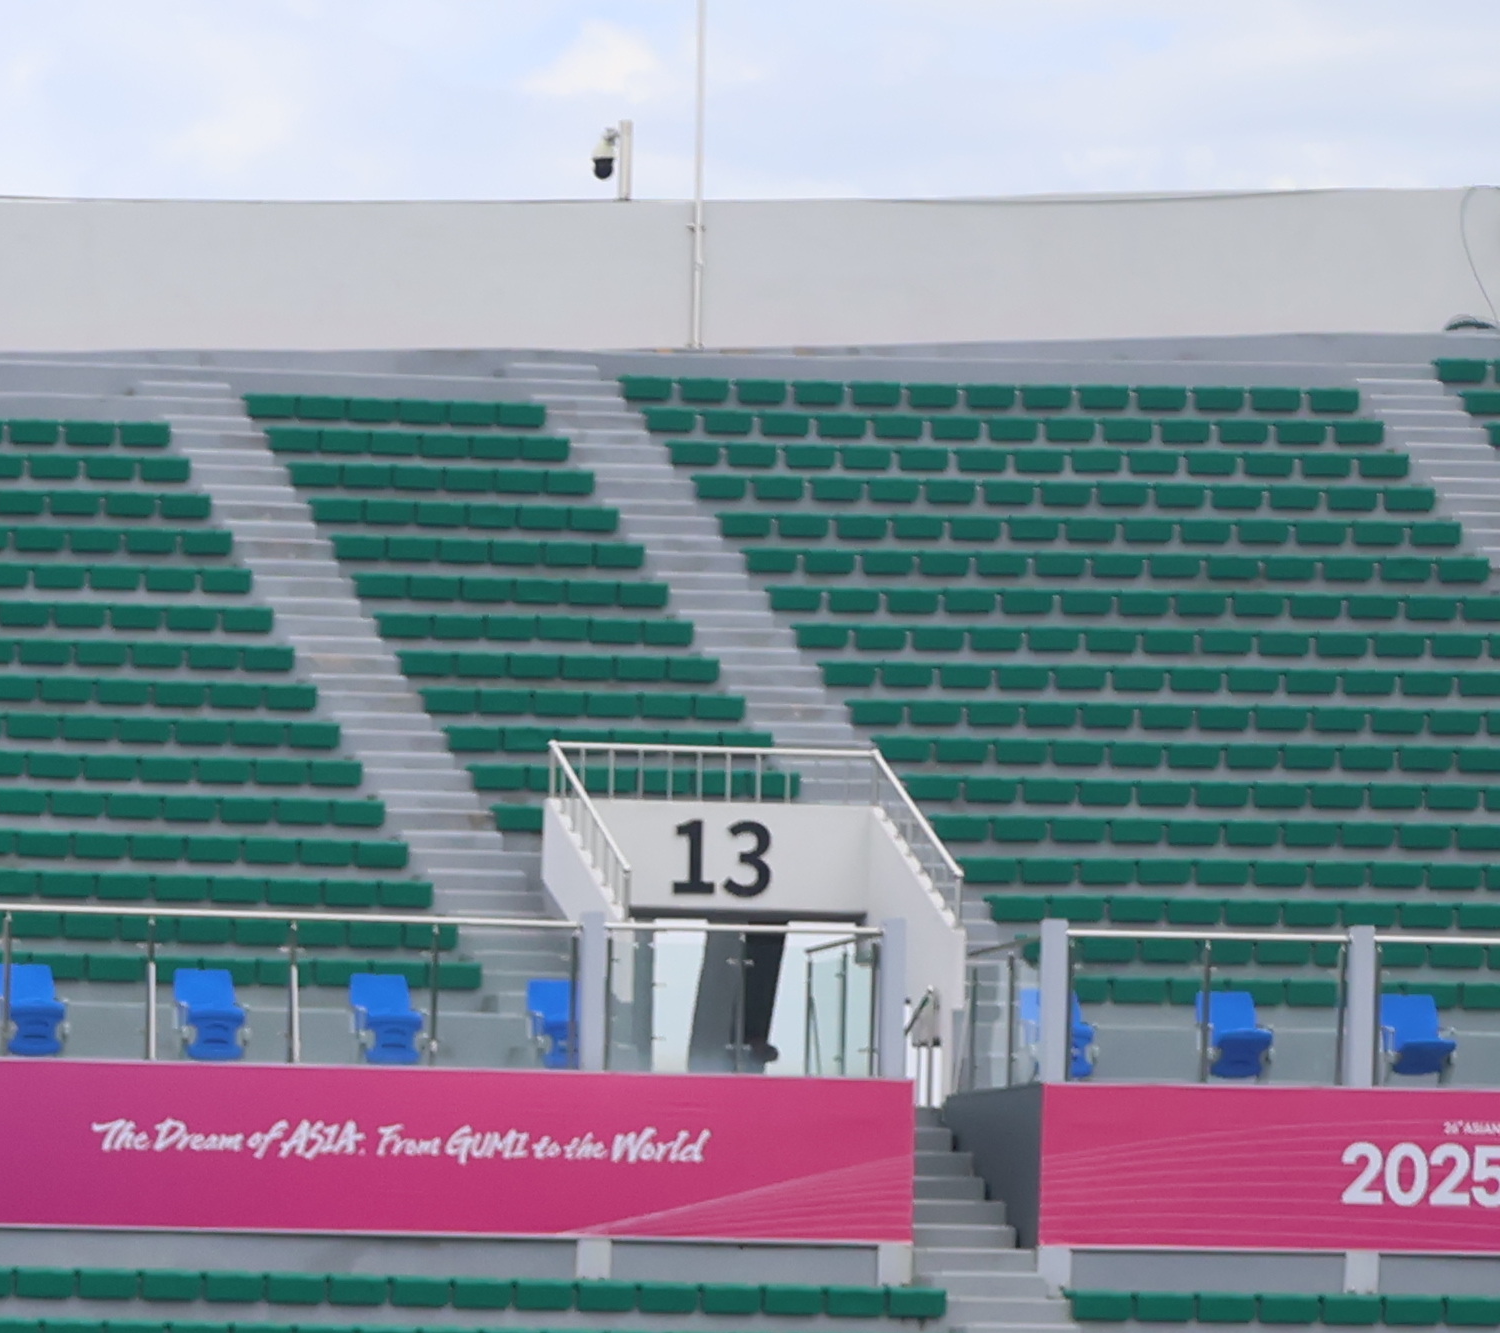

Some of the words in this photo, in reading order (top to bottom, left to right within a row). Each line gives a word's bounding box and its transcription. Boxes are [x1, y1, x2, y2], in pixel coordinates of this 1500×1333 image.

[671, 819, 772, 898] 13
[91, 1118, 151, 1152] The
[152, 1117, 245, 1152] Dream
[247, 1119, 290, 1160] of
[376, 1123, 442, 1158] From
[444, 1124, 531, 1166] GUMI
[532, 1134, 564, 1160] to
[563, 1131, 609, 1161] the
[609, 1126, 713, 1164] World
[1341, 1141, 1500, 1208] 2025
